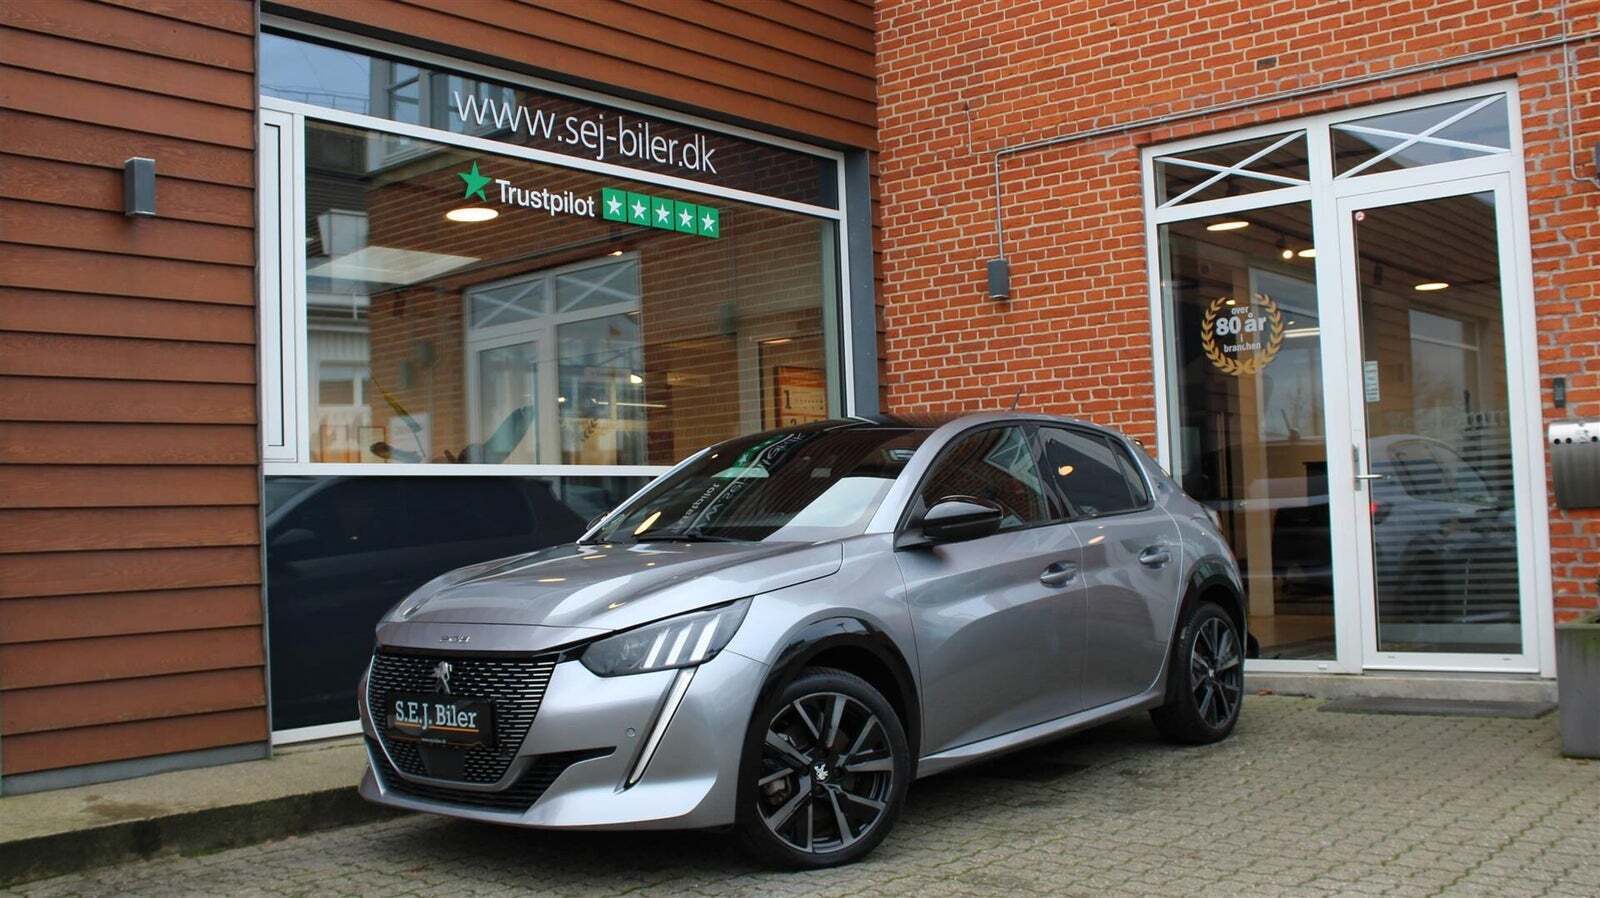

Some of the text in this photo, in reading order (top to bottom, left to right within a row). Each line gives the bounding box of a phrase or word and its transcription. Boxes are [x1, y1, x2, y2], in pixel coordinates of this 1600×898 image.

[454, 91, 717, 174] www.sej-biler.dk
[495, 179, 595, 217] Trustpilot
[1216, 312, 1267, 336] 80 år
[1231, 306, 1249, 315] over
[395, 700, 477, 730] S.E.J. Biler
